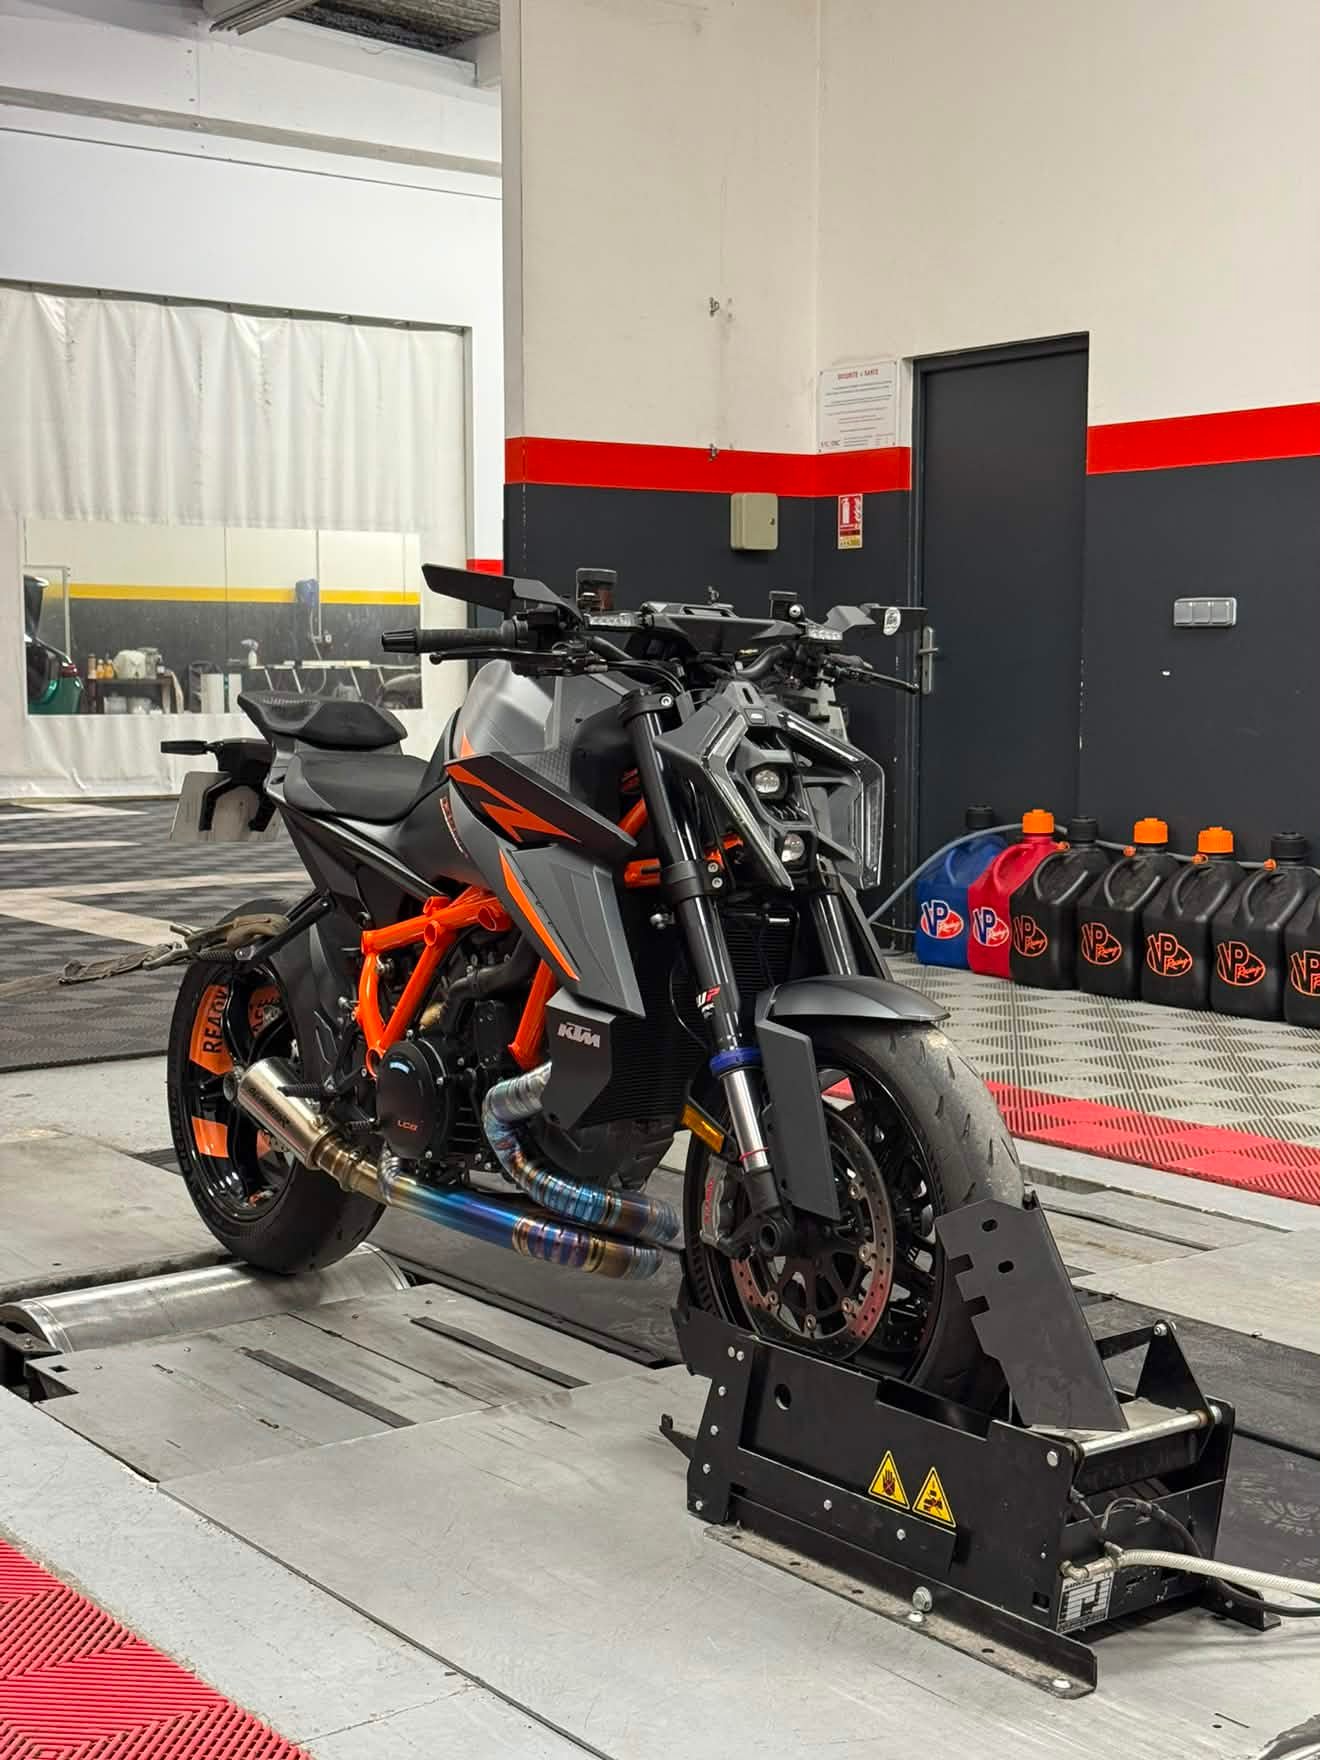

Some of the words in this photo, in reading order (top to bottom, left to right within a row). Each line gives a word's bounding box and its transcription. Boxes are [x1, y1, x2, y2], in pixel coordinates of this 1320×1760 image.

[921, 900, 950, 937] VP
[972, 907, 998, 946] VP
[1013, 915, 1036, 956] VP
[1081, 922, 1108, 963] VP
[1147, 933, 1178, 975] VP
[1217, 941, 1250, 985] VP
[1291, 950, 1320, 995] VP
[557, 1022, 601, 1048] KTM
